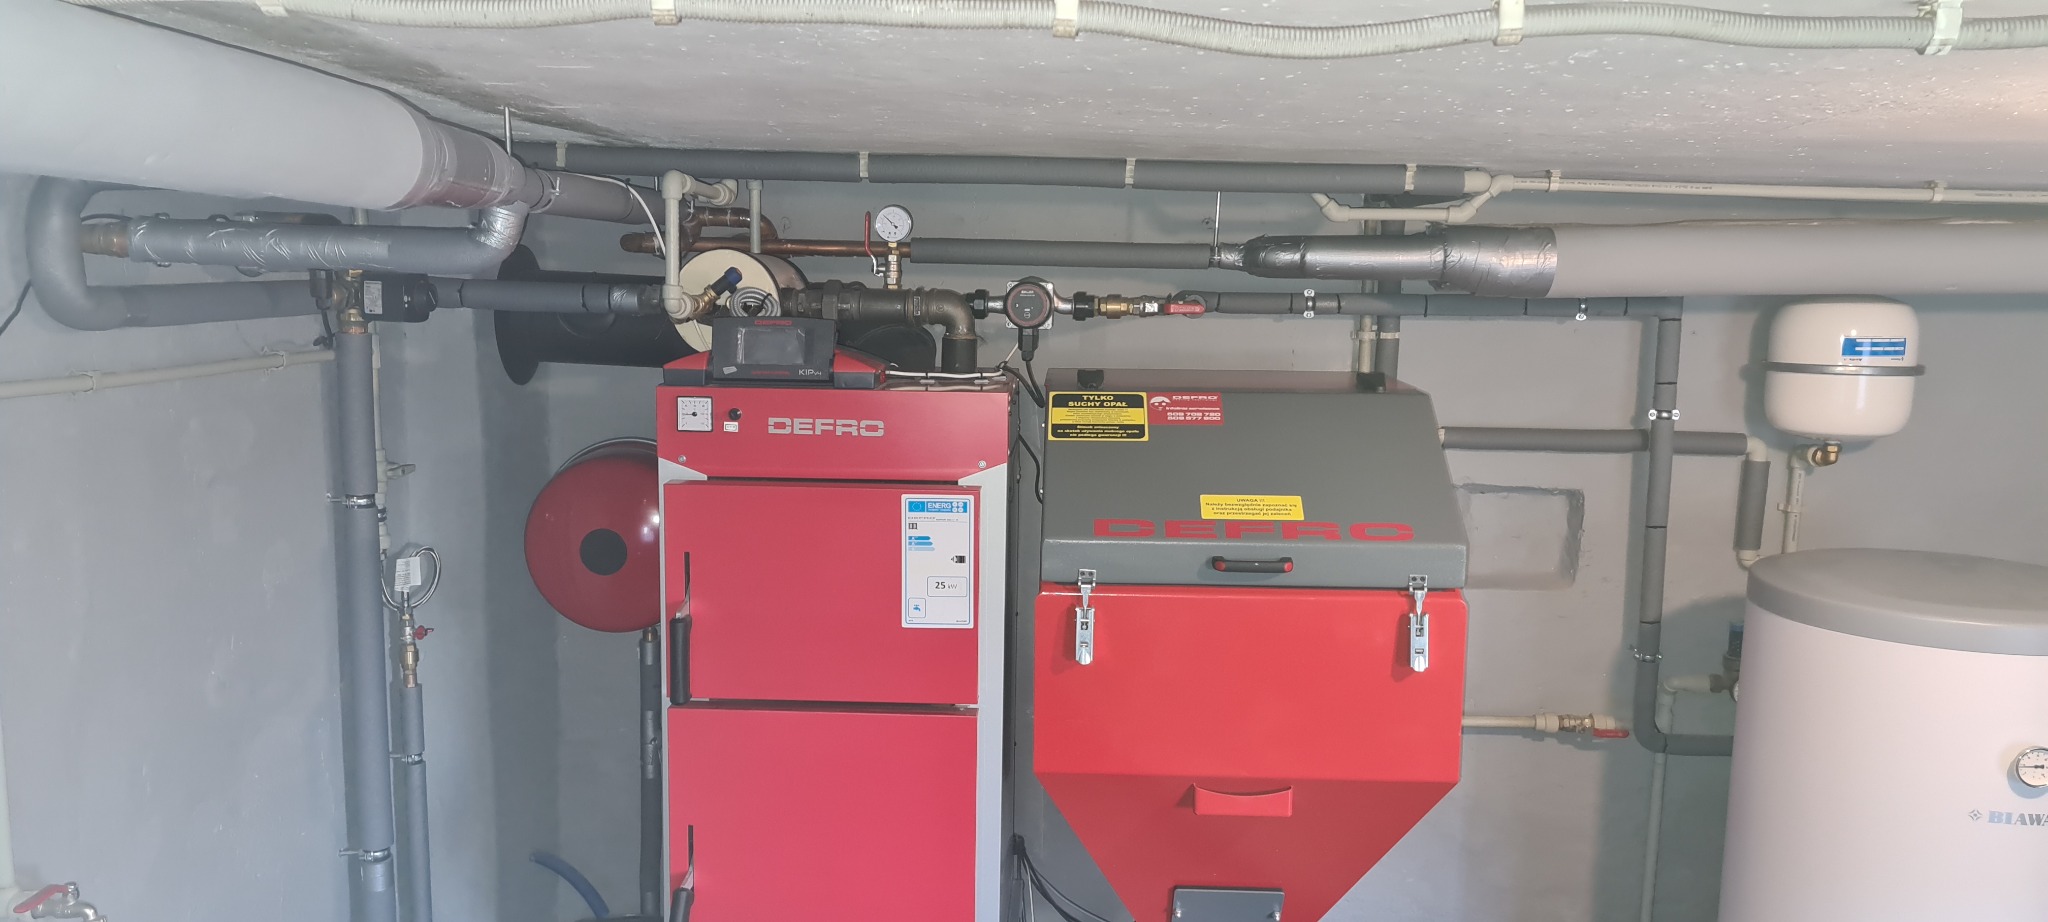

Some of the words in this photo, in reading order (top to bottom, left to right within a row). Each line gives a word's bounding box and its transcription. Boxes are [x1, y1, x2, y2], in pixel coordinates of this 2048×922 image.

[768, 417, 885, 437] DEFRO
[1093, 518, 1415, 542] DEFRO
[935, 581, 946, 589] 25
